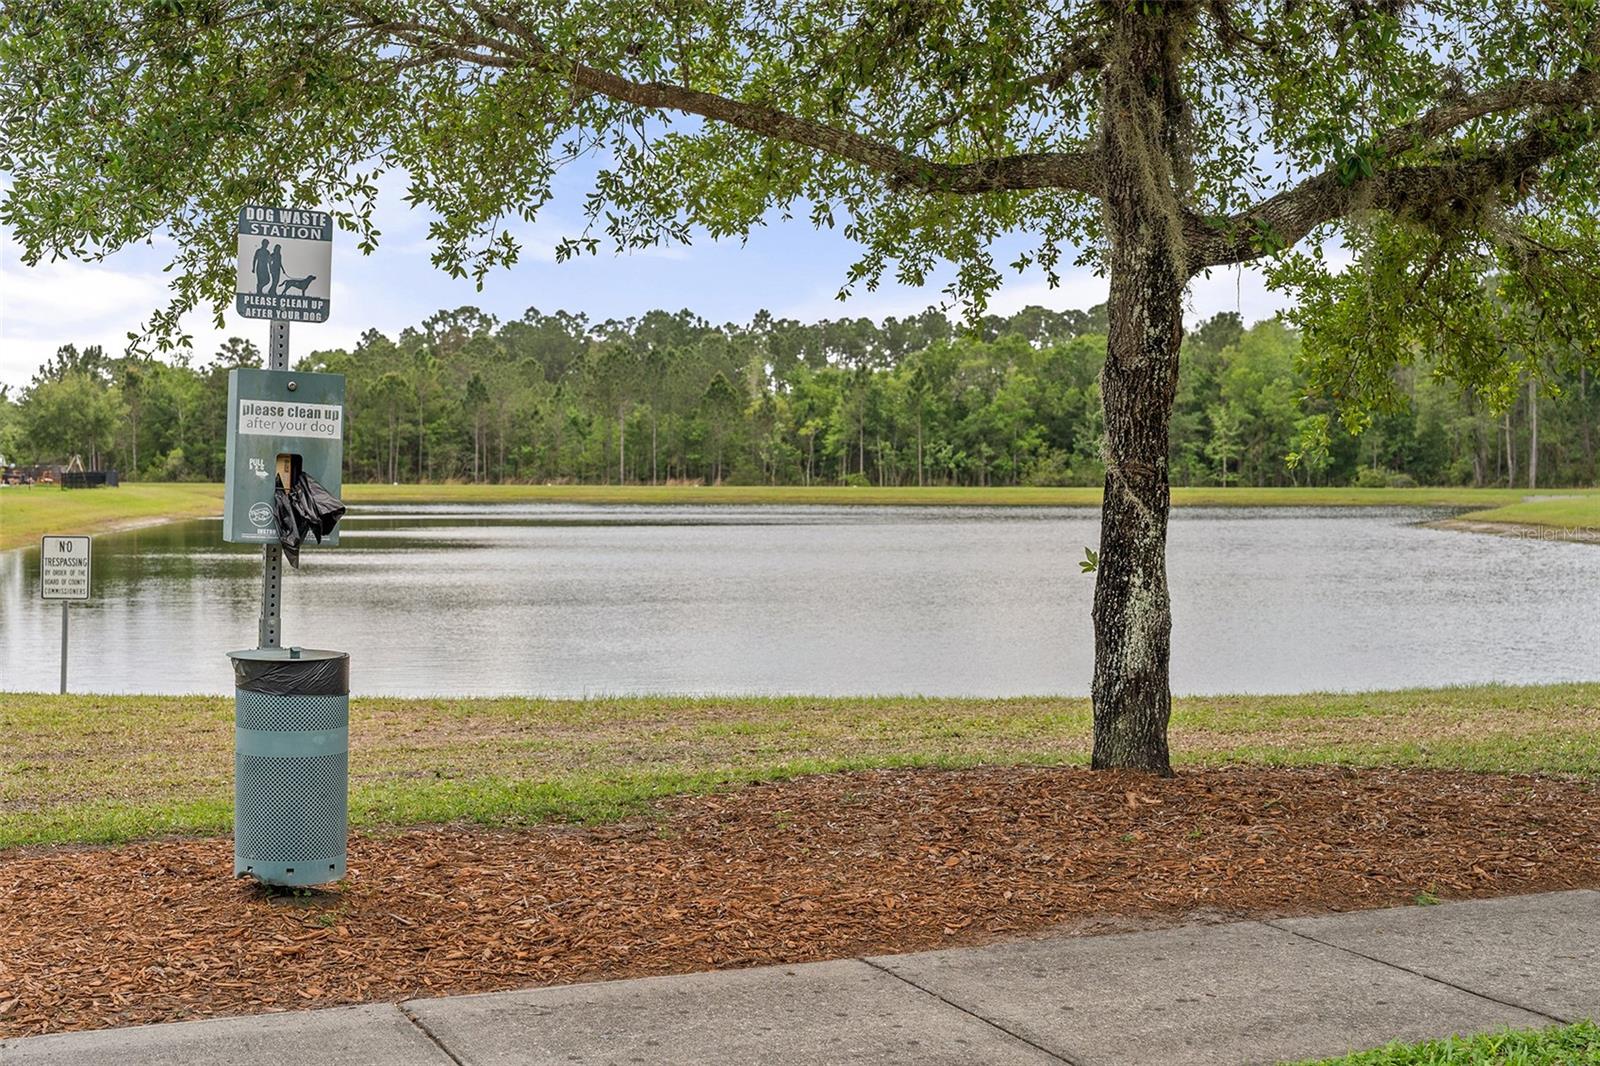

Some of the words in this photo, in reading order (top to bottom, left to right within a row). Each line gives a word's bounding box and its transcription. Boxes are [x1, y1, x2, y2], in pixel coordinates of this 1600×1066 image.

[246, 207, 274, 222] DOG
[279, 210, 326, 227] WASTE
[250, 223, 321, 240] STATION
[244, 295, 277, 306] PLEASE
[280, 298, 308, 309] CLEAN
[311, 300, 324, 309] UP
[245, 308, 273, 318] AFTER
[276, 309, 300, 320] YOUR
[303, 312, 322, 321] DOG
[242, 403, 284, 417] please
[287, 406, 321, 419] clean
[324, 409, 339, 421] up
[246, 416, 276, 429] after
[279, 421, 307, 433] your
[310, 420, 335, 436] dog
[249, 458, 265, 467] PULL
[59, 540, 73, 553] NO
[45, 557, 88, 567] TRESPASSING
